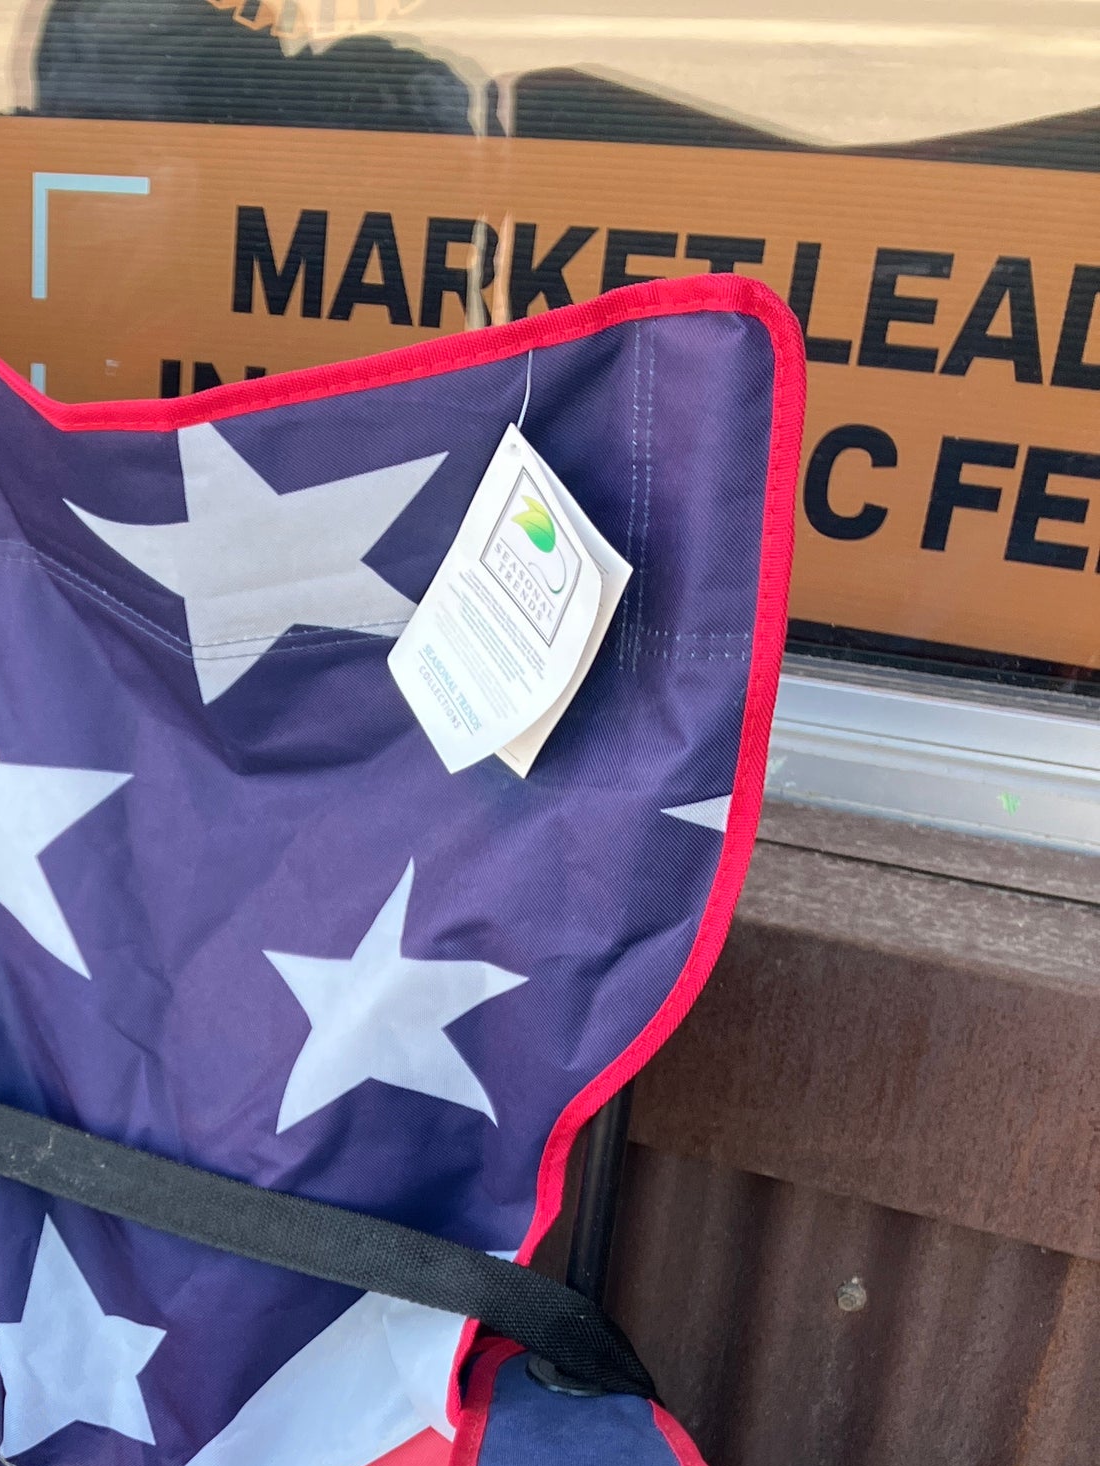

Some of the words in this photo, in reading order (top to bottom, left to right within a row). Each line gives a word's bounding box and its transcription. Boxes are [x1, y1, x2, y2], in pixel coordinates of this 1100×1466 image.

[920, 435, 1100, 576] FE
[494, 543, 553, 622] SEASONAL
[498, 561, 542, 621] TRENDS
[419, 665, 461, 729] COLLECTIONS
[422, 644, 457, 694] SEASONAL
[457, 692, 482, 730] TRENDS
